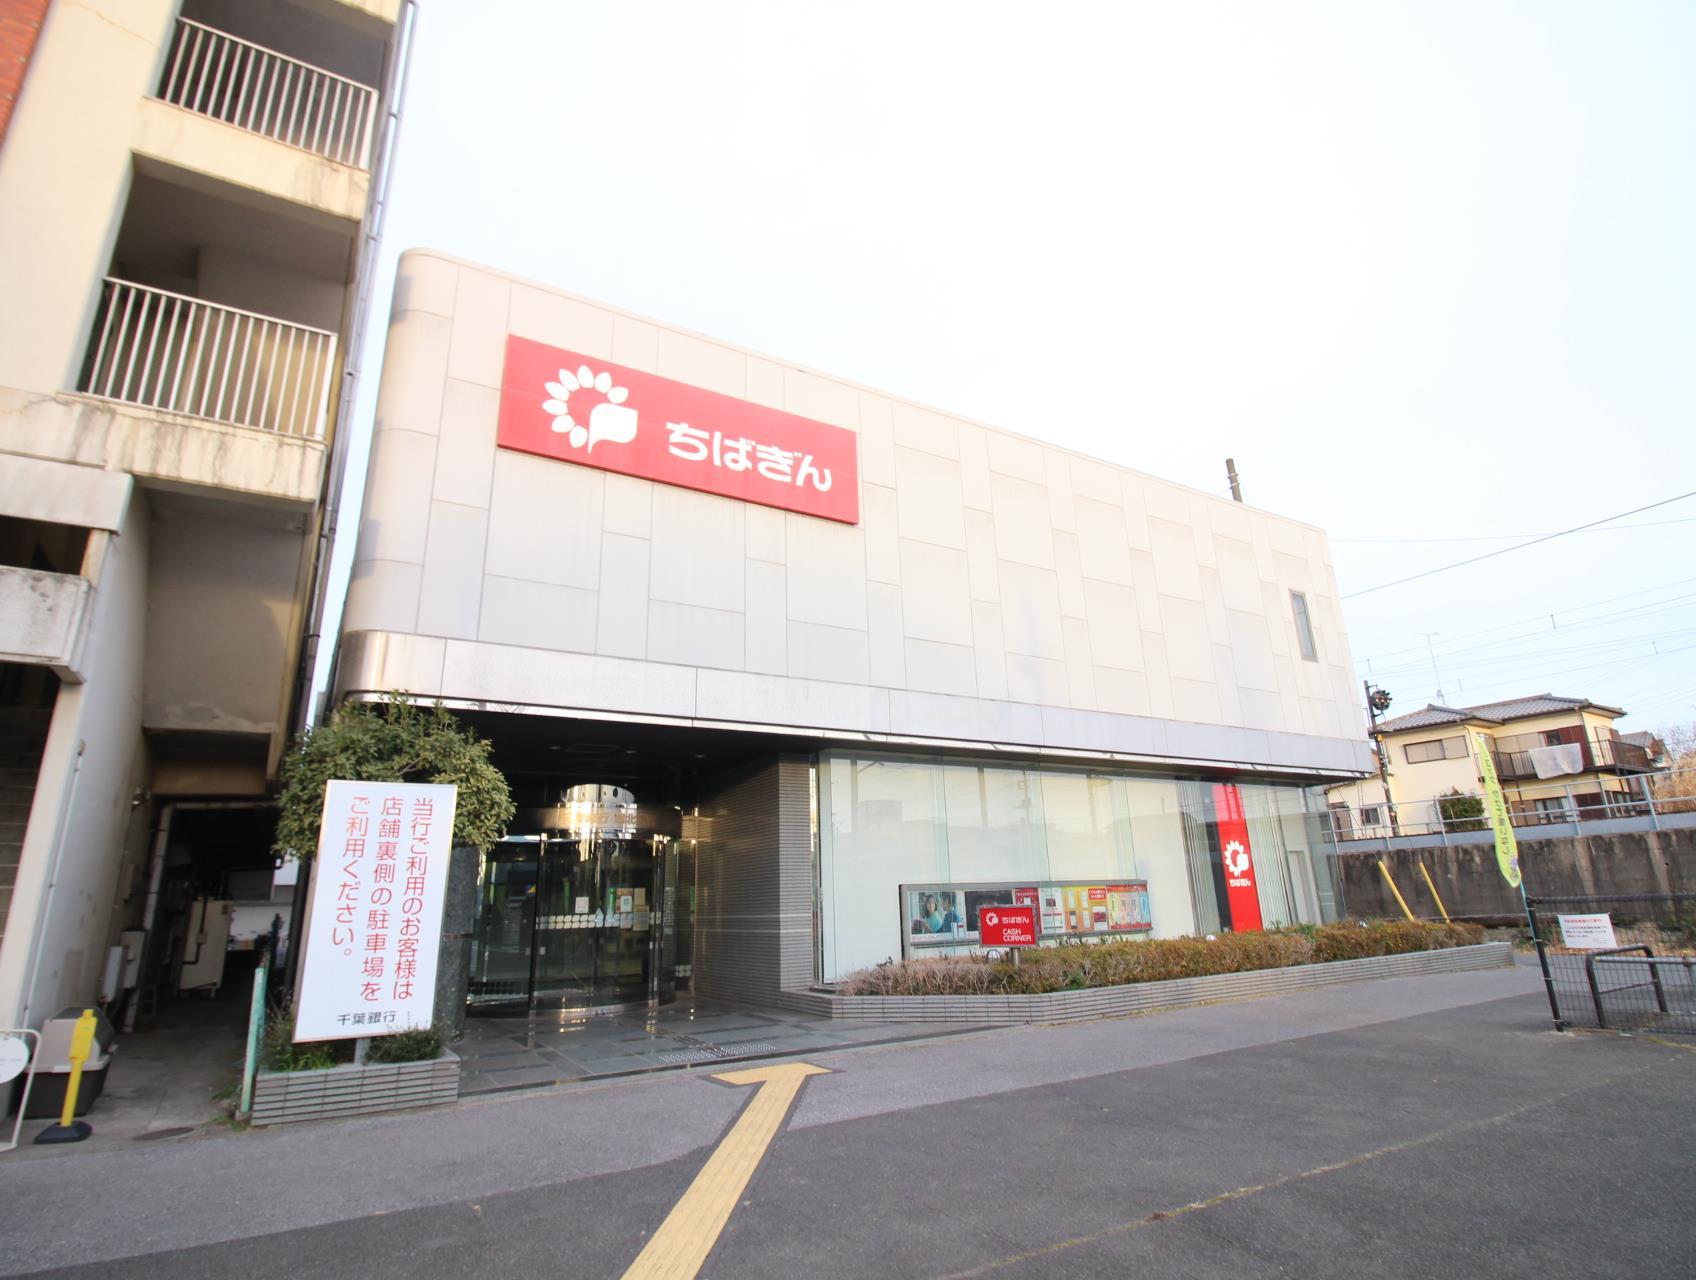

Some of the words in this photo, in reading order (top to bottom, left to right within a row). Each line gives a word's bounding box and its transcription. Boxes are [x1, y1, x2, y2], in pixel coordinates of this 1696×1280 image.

[665, 421, 833, 493] ちばぎん
[331, 795, 371, 957] ご利用ください。
[359, 796, 404, 1002] 店舗裏側の駐車場を
[392, 797, 433, 1000] 当行ご利用のお客様は
[1002, 916, 1029, 924] ちばぎん
[336, 1010, 397, 1026] 千葉銀行
